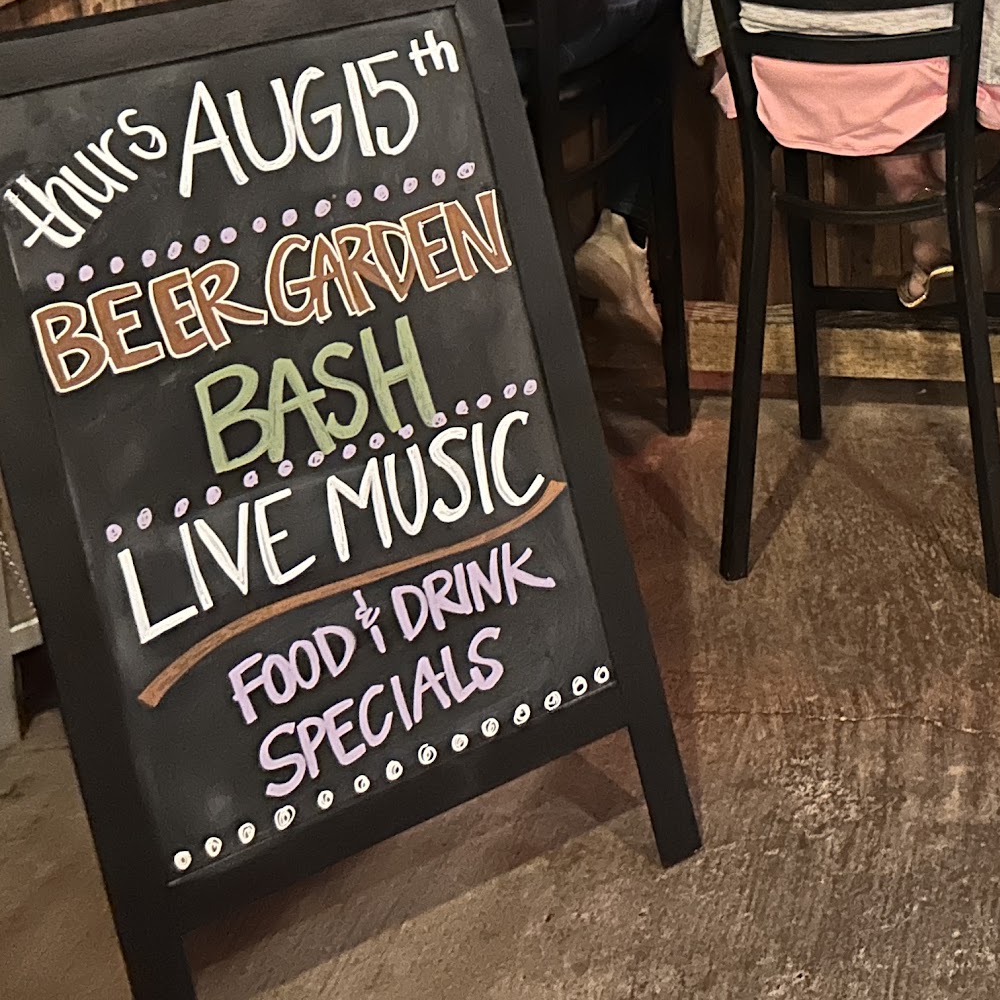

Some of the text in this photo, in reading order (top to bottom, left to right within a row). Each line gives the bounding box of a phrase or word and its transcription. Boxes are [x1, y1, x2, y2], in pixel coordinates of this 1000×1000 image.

[3, 108, 167, 249] thurs
[31, 188, 512, 394] BEER GARDEN
[195, 315, 437, 475] BASH
[117, 410, 545, 645] LIVE MUSIC
[227, 624, 357, 726] FOOD
[390, 541, 556, 641] DRINK
[258, 626, 505, 797] SPECIALS
